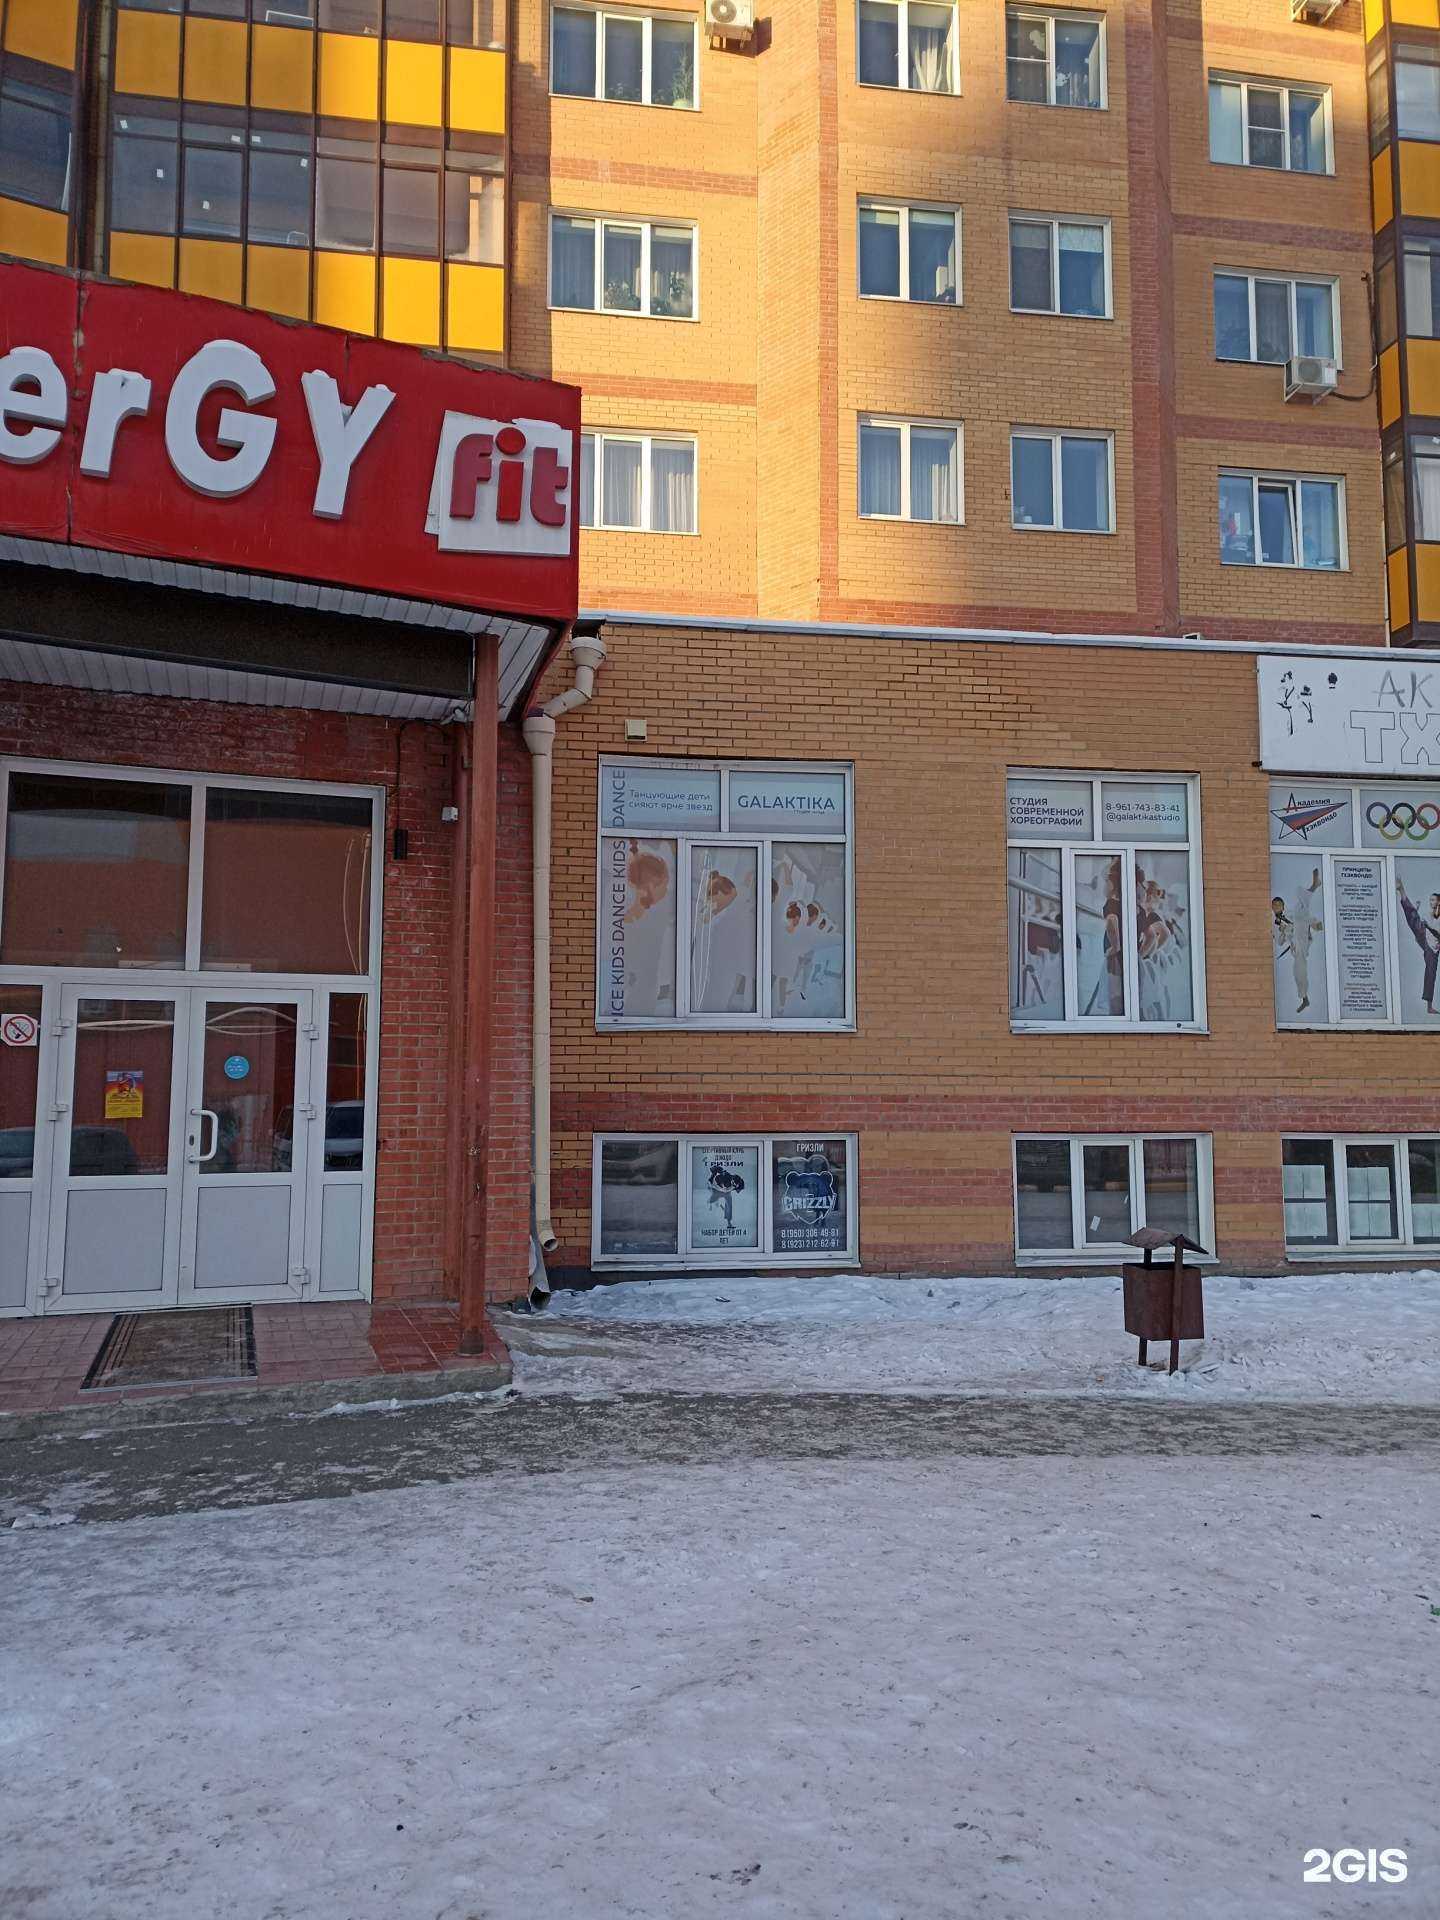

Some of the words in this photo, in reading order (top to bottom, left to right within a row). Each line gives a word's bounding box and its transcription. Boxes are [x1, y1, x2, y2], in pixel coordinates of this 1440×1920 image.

[449, 427, 569, 527] fit
[612, 769, 625, 828] DANCE
[629, 790, 685, 801] Танцующие
[688, 793, 711, 801] дети
[1010, 797, 1048, 806] СТУДИЯ
[629, 800, 659, 809] сияют
[661, 803, 684, 812] ярче
[737, 795, 835, 810] GALAKTIKA
[1105, 803, 1180, 812] 8-961-743-83-41
[1010, 807, 1085, 817] СОВРЕМЕННОЙ
[1106, 812, 1181, 821] @galaktikastudio
[1010, 816, 1083, 826] ХОРЕОГРАФИИ
[613, 840, 626, 878] KIDS
[612, 883, 626, 941] DANCE
[612, 946, 625, 985] KIDS
[611, 990, 625, 1017] ICE
[796, 1143, 824, 1152] ГРИЗЛИ
[783, 1194, 836, 1210] GRIZZLY
